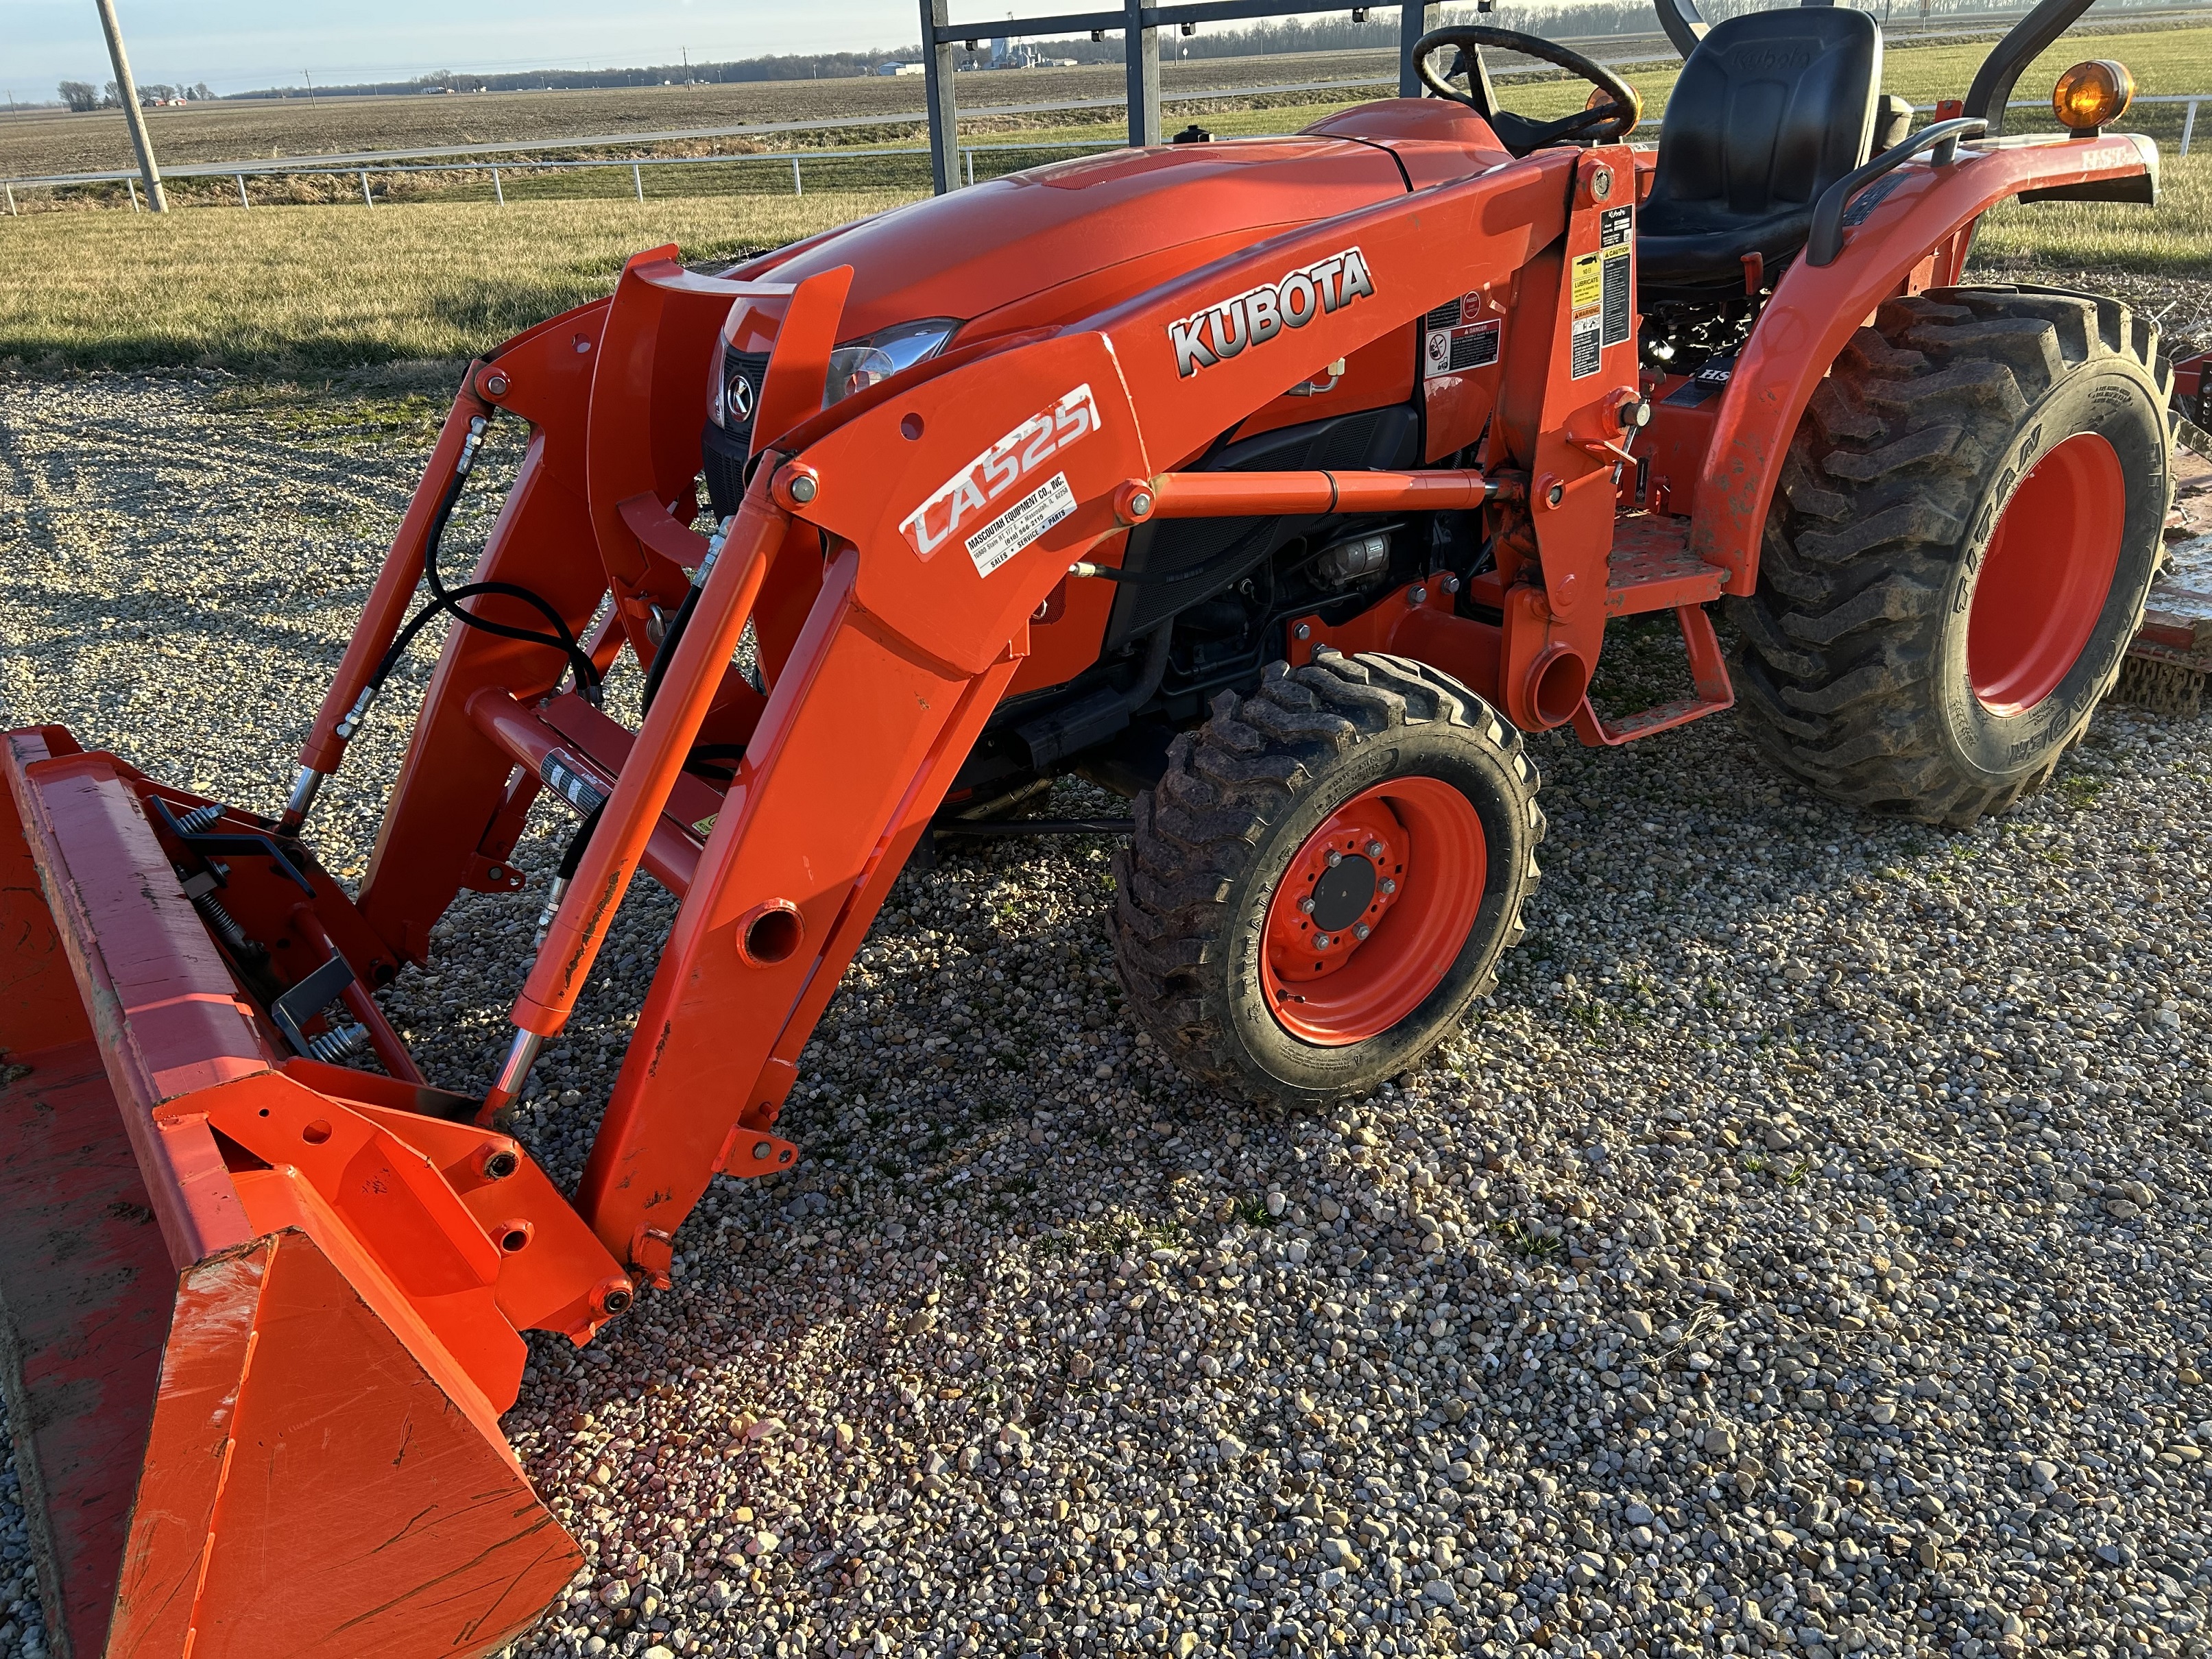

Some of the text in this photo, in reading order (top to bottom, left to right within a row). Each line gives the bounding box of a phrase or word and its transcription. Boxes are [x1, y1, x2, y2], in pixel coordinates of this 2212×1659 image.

[1609, 246, 1630, 256] CAUTION
[1574, 277, 1599, 288] LUBRICATE
[1171, 250, 1375, 378] KUBOTA
[1469, 325, 1487, 334] DANGER
[1578, 306, 1599, 317] WARNING
[967, 520, 1005, 550] MASCOUTAH
[1005, 494, 1038, 524] EQUIPMENT
[1050, 476, 1065, 490] INC.
[1024, 502, 1049, 522] Mascoutah,
[1952, 423, 2043, 614] TITAN
[990, 509, 1066, 568] SALES SERVICE PARTS
[1242, 880, 1274, 997] TITAN
